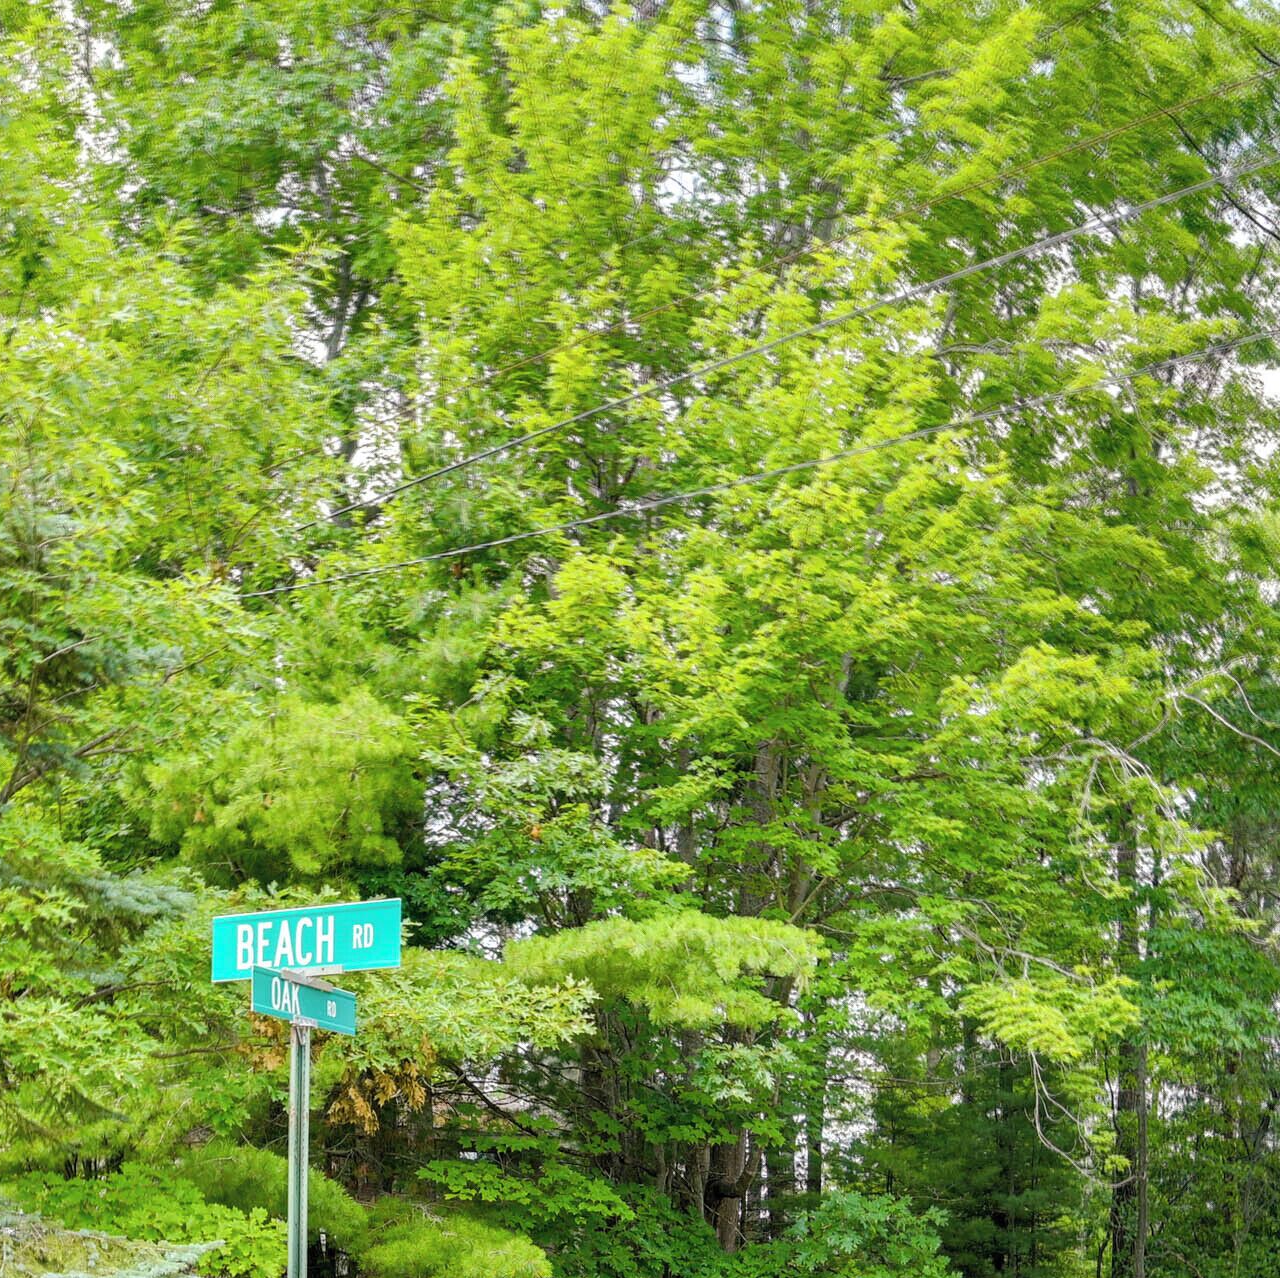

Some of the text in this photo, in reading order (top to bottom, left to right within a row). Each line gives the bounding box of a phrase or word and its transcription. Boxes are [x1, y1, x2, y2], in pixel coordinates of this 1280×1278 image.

[236, 915, 374, 971] BEACH RD
[271, 976, 337, 1018] OAK RD
